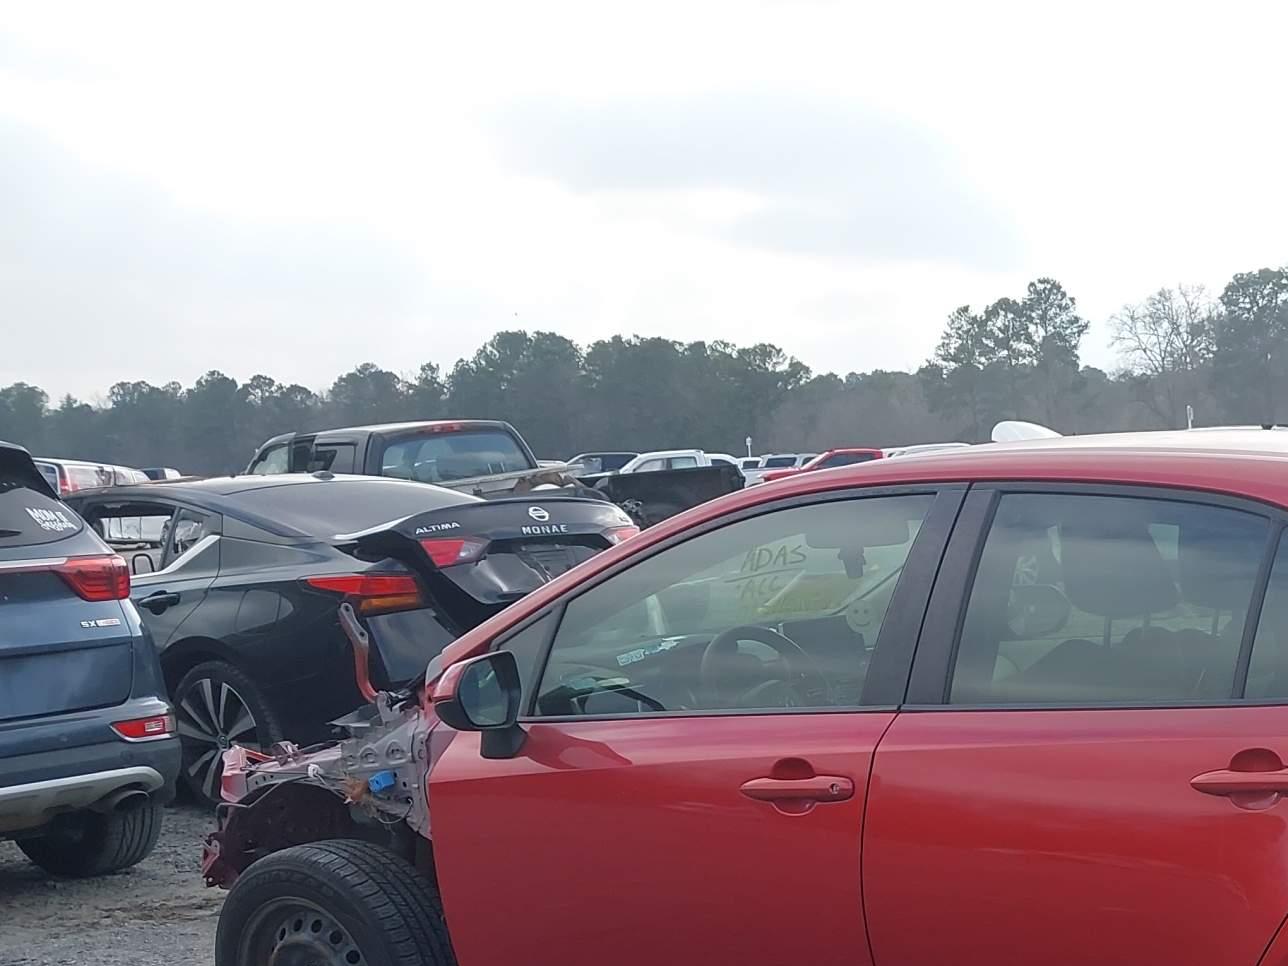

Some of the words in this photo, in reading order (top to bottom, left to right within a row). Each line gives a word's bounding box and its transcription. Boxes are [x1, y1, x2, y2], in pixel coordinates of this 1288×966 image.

[415, 522, 460, 535] ALTIMA
[521, 524, 569, 535] MONAE
[80, 620, 97, 628] SX
